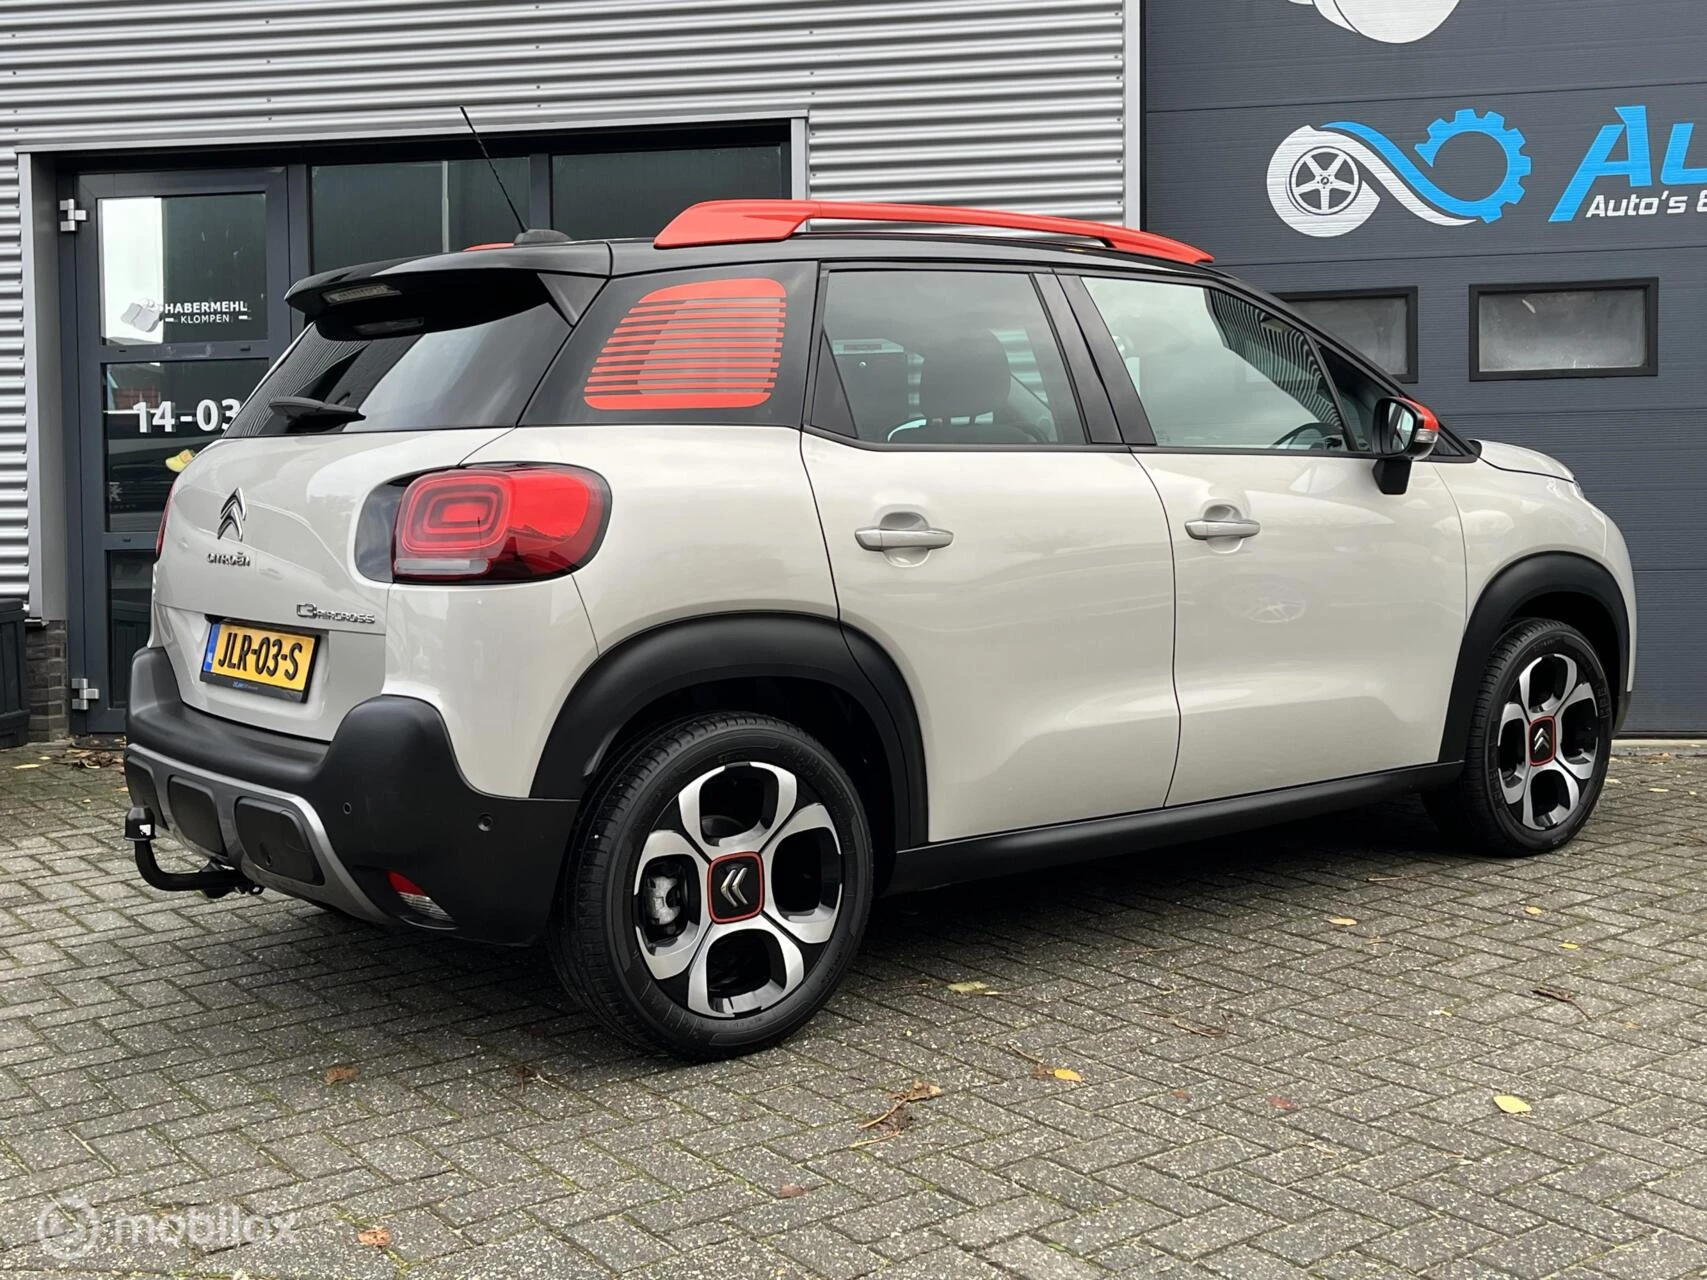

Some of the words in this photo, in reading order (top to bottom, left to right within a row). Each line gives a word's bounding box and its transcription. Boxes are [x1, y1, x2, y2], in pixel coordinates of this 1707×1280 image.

[1586, 190, 1689, 217] Auto's
[165, 301, 248, 313] HABERMEHL
[180, 314, 230, 324] KLOMPEN
[218, 632, 303, 681] JLR-03-S
